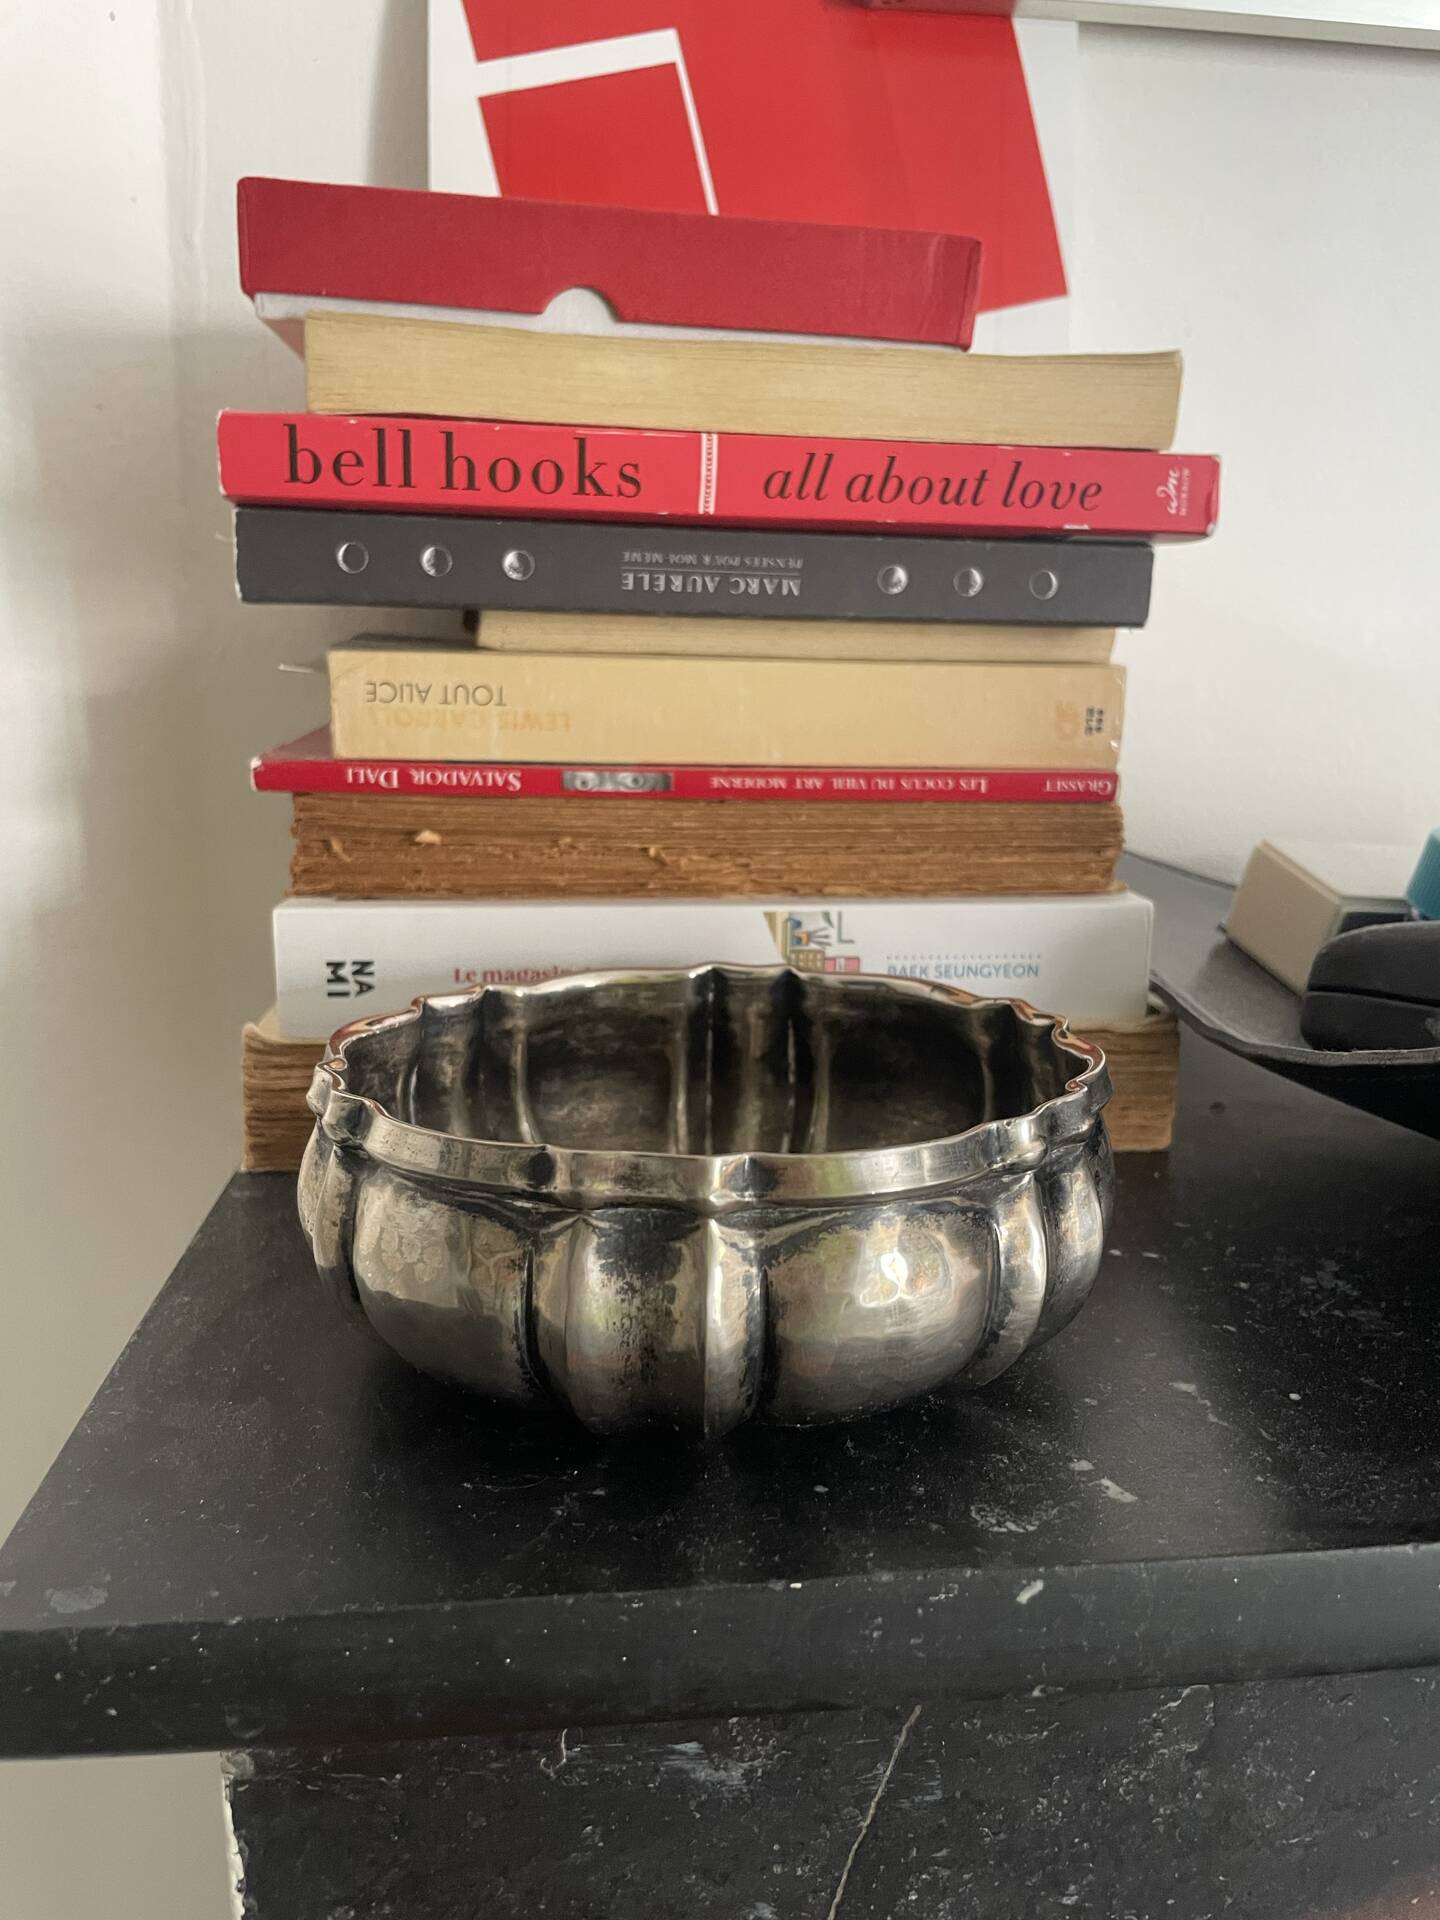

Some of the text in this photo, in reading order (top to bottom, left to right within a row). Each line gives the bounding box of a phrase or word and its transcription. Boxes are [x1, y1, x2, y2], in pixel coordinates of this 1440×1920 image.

[284, 424, 642, 498] bell hooks
[763, 452, 1103, 511] all about love
[728, 577, 801, 597] MARC
[363, 681, 507, 708] TOUT ALICE
[794, 777, 824, 790] ART
[454, 967, 477, 983] Le
[483, 965, 573, 983] magasi
[887, 963, 1040, 978] BAEK SEUNGYEON
